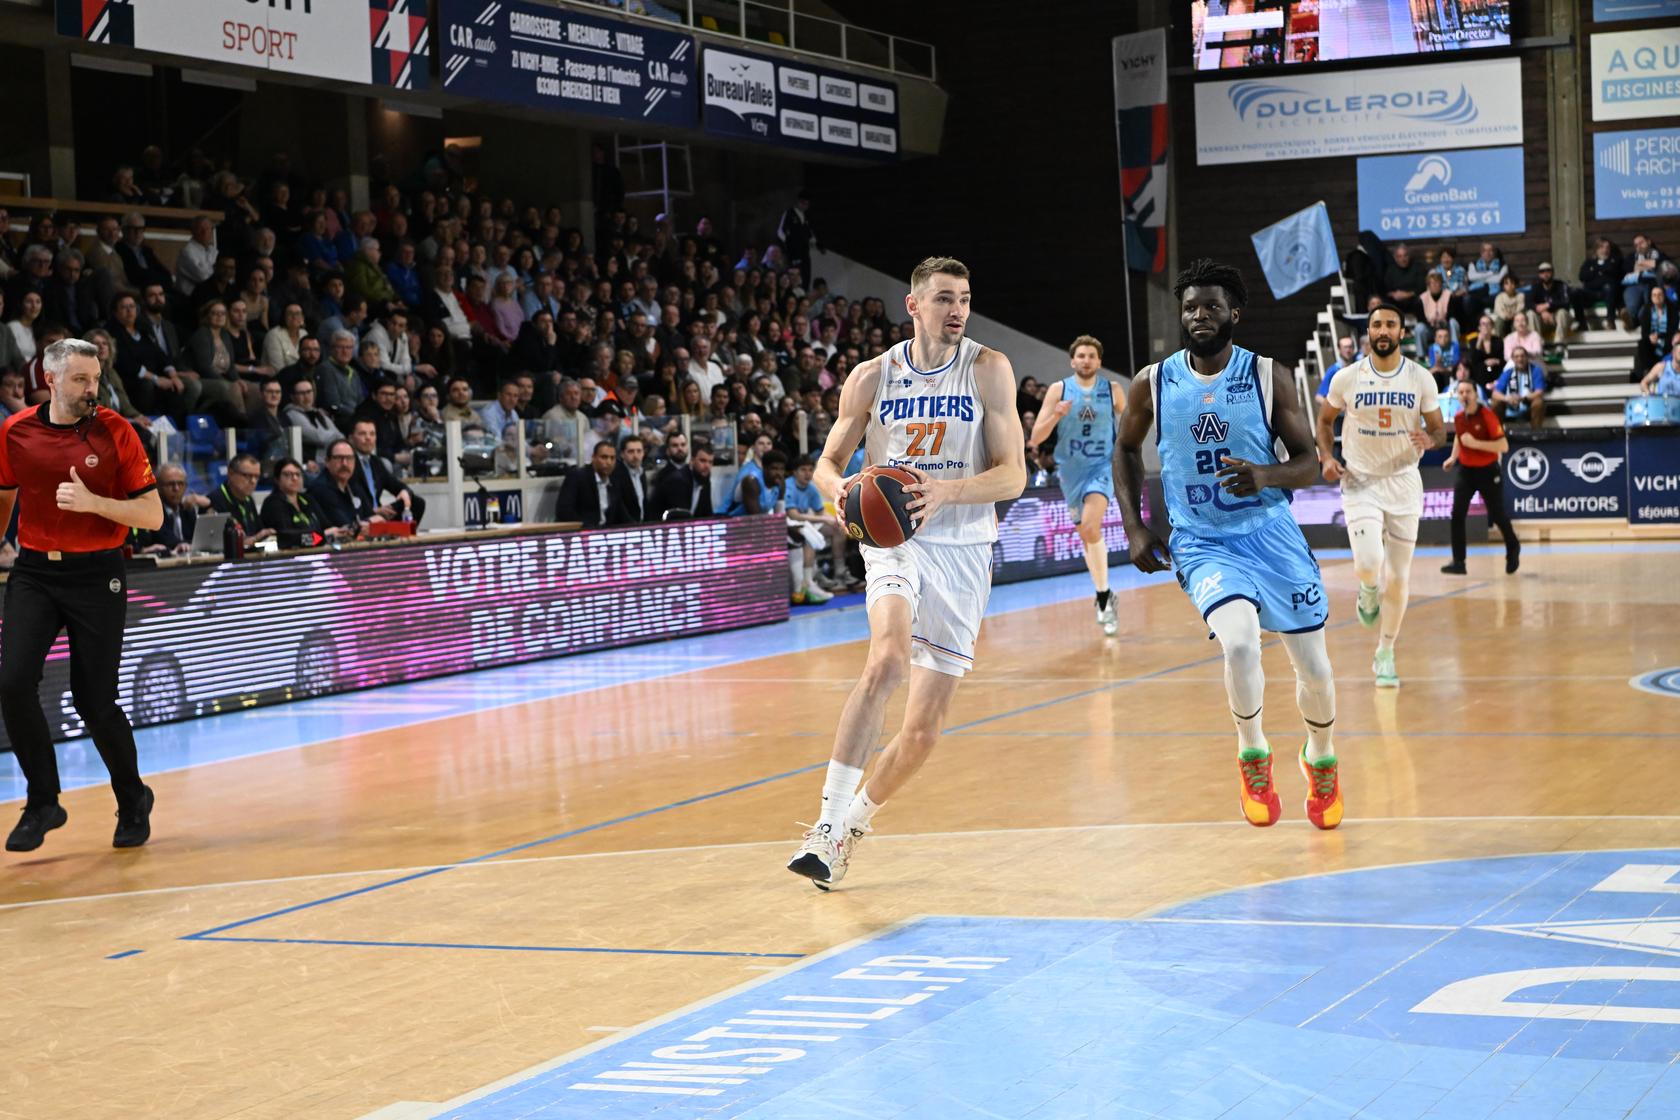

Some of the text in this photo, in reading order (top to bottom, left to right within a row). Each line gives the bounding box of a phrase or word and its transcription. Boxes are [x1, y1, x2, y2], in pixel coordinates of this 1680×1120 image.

[222, 20, 298, 61] SPORT
[450, 24, 496, 53] CAR auto
[648, 60, 669, 82] CAR
[1120, 53, 1158, 72] VICHY
[1607, 81, 1680, 99] PISCINES
[1256, 90, 1449, 119] DUCLEROIR
[1404, 187, 1477, 204] GreenBati
[1621, 187, 1650, 199] Vichy
[1381, 209, 1501, 231] 04 70 55 26 61
[880, 395, 974, 426] POITIERS
[1354, 391, 1416, 409] POITIERS
[1378, 407, 1392, 429] 5
[906, 422, 947, 457] 27
[914, 460, 944, 471] Immo
[946, 460, 964, 469] Pro
[1582, 461, 1604, 473] MINI
[1514, 494, 1619, 513] HÉLI-MOTORS
[1638, 504, 1680, 520] SÉJOURS
[425, 523, 728, 602] VOTRE PARTENAIRE
[470, 582, 703, 662] DE CONFIANCE
[568, 954, 1011, 1097] INSTILL.FR
